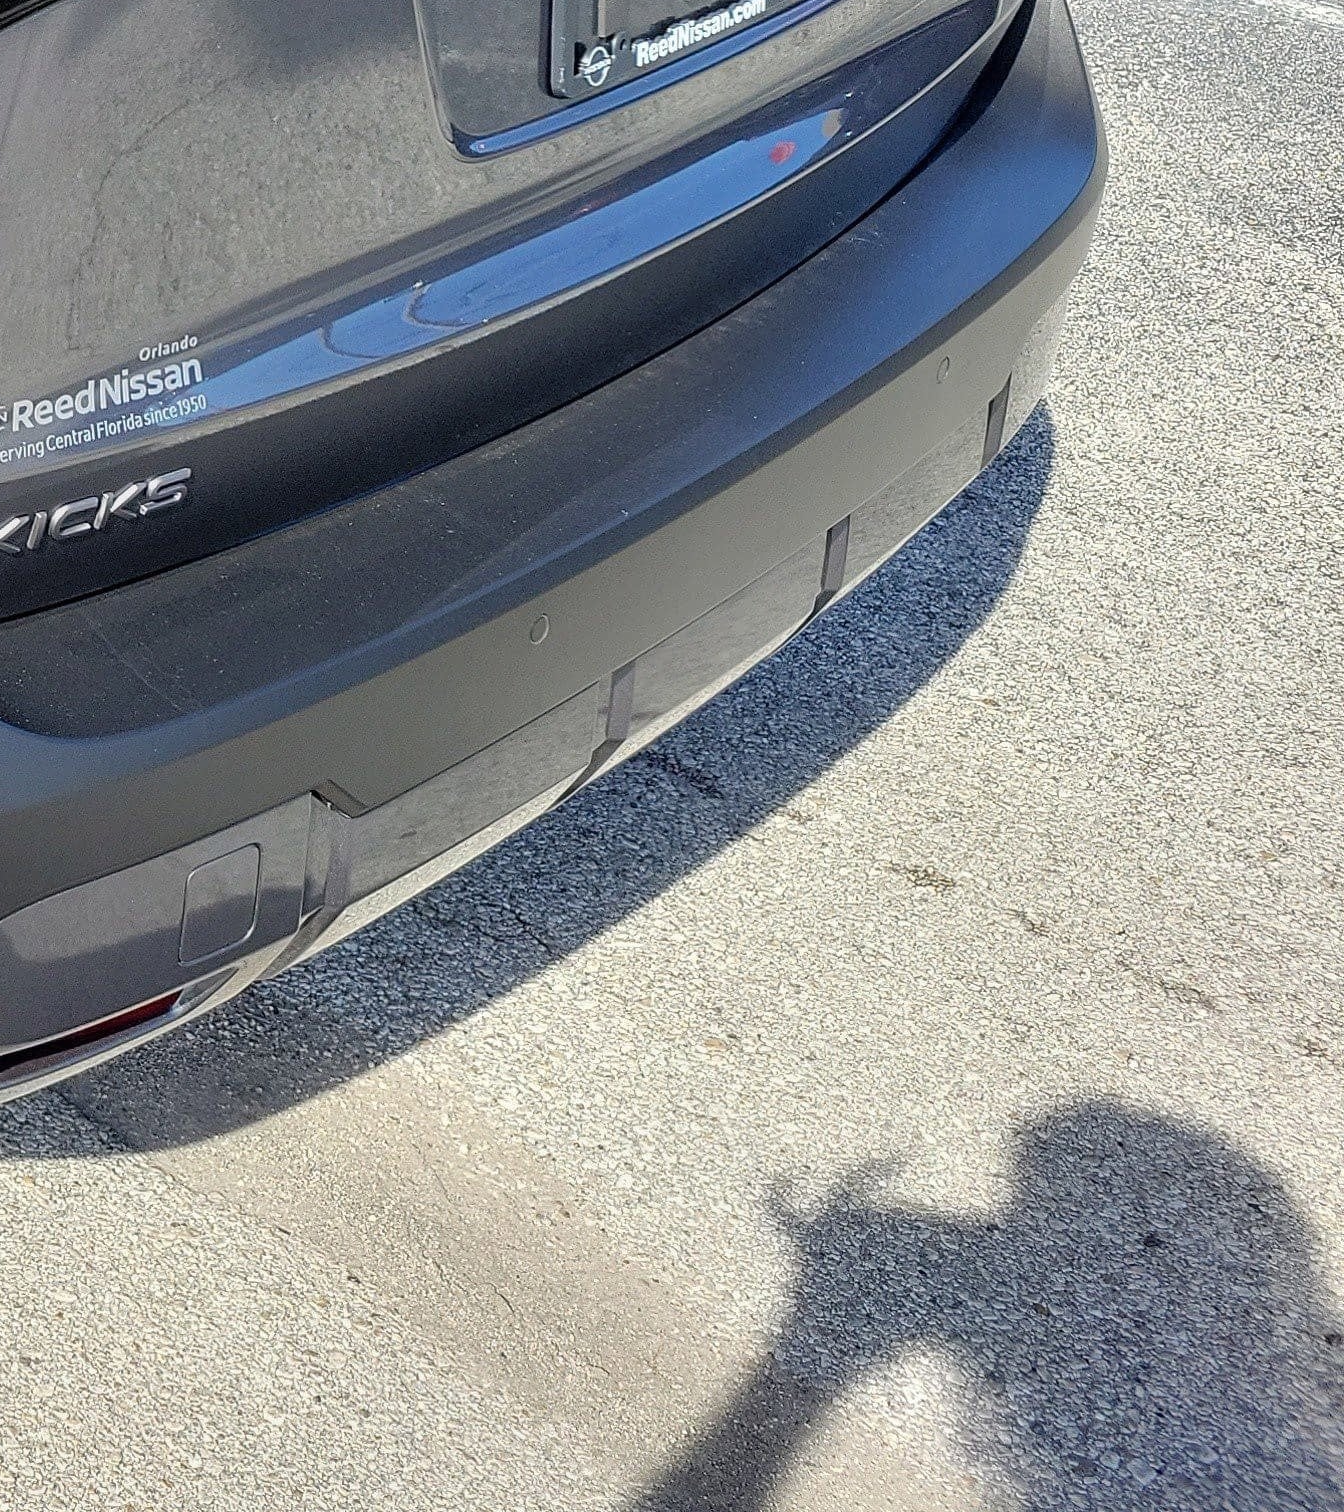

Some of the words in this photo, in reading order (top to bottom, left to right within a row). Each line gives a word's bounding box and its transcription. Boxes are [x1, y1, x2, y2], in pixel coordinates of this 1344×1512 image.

[138, 334, 199, 363] Orlando
[12, 380, 96, 433] Reed
[100, 358, 203, 410] Nissan
[46, 423, 96, 452] Central
[96, 413, 143, 440] Florida
[143, 401, 179, 426] since
[177, 394, 207, 417] 1950
